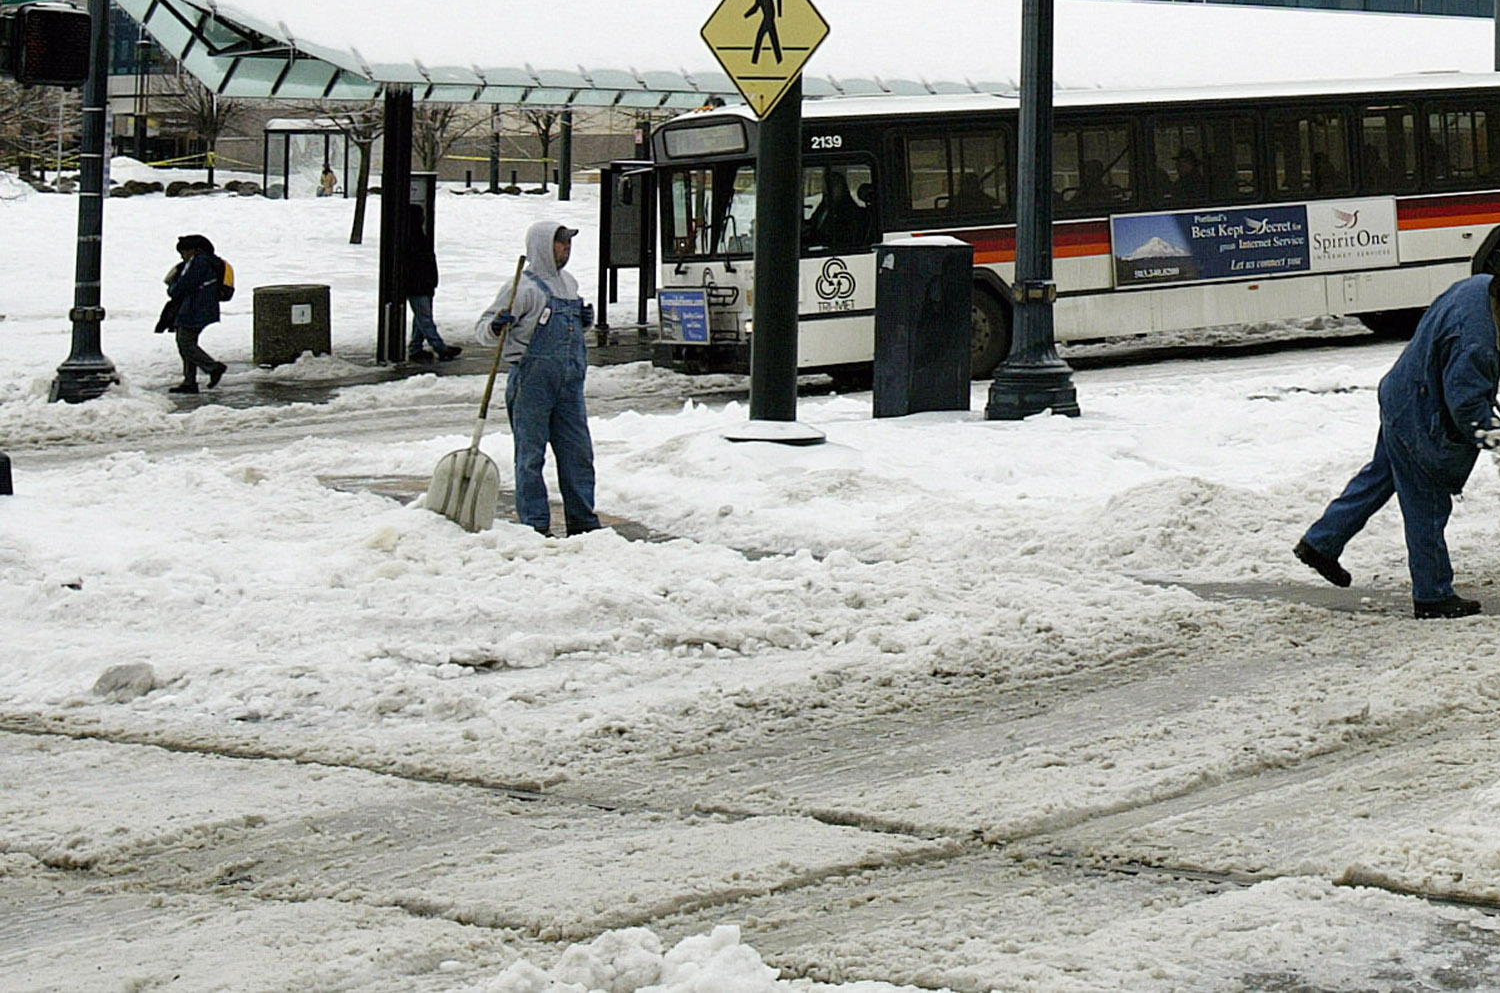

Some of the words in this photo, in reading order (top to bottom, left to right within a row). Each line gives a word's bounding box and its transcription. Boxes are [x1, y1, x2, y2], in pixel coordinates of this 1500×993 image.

[811, 135, 842, 149] 2139
[1191, 225, 1216, 239] Best
[1218, 224, 1244, 238] Kept
[1239, 239, 1272, 249] Internet
[1273, 236, 1305, 247] Service
[1356, 249, 1391, 257] SERVICES
[1231, 259, 1244, 270] Let
[817, 299, 856, 313] TRI-MET
